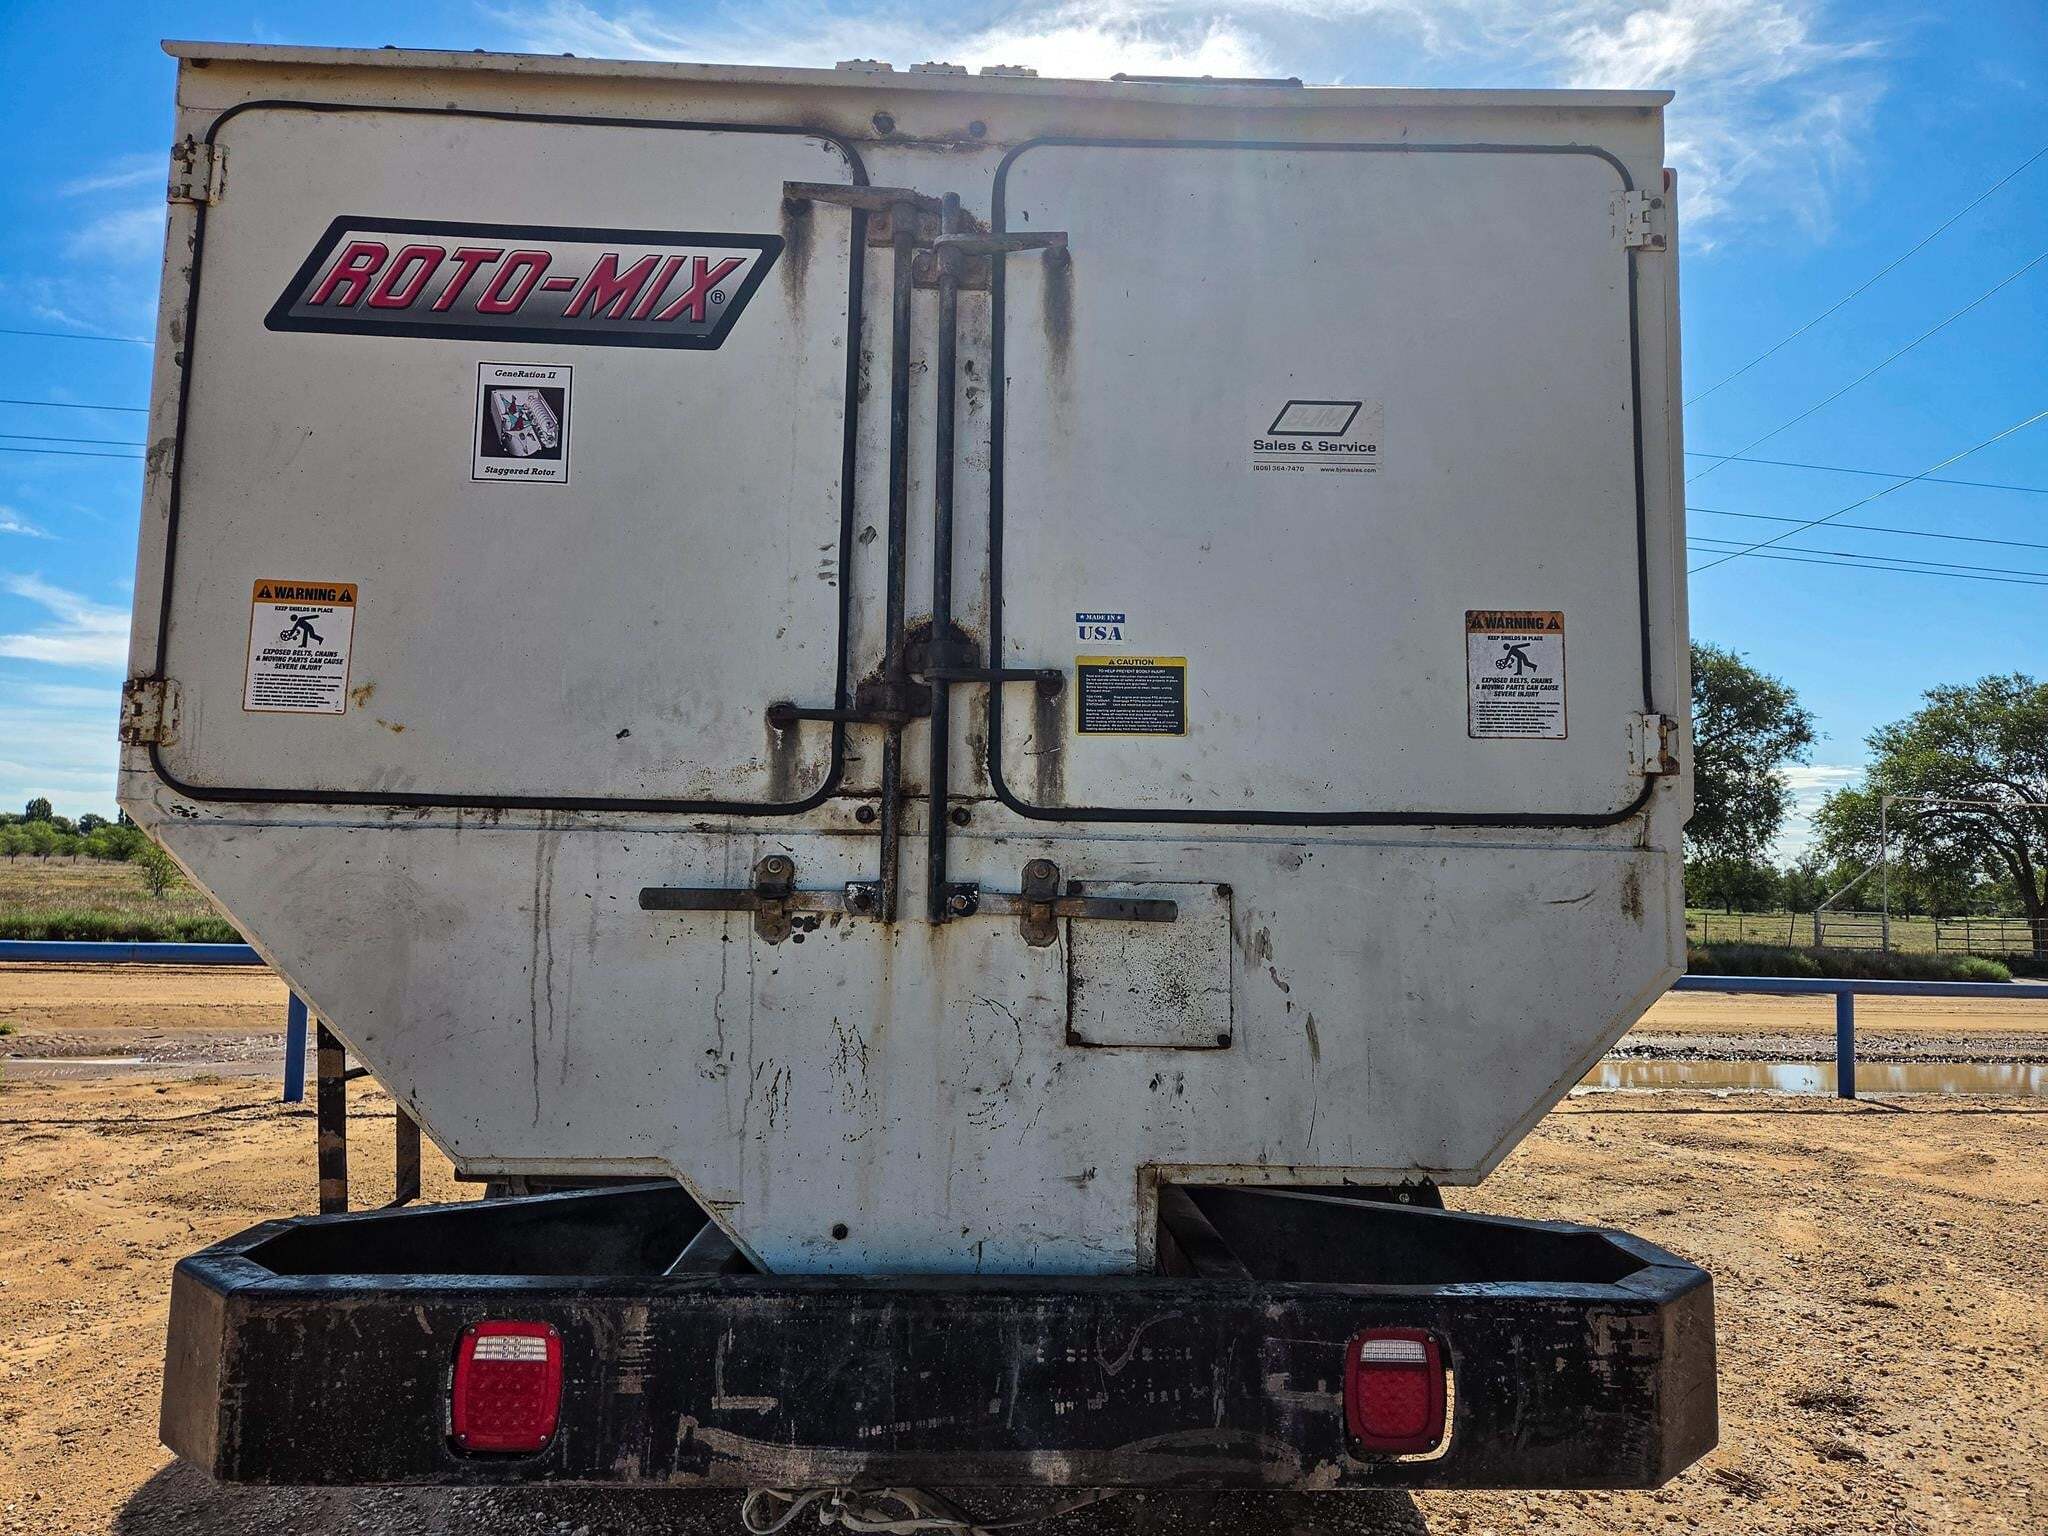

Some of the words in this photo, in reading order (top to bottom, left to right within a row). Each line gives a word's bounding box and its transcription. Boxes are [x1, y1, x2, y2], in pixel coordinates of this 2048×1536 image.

[306, 241, 747, 322] ROTO-MIX
[495, 369, 546, 379] GeneRation
[547, 371, 557, 379] II
[1253, 439, 1296, 451] Sales
[1301, 441, 1313, 451] &
[1318, 441, 1376, 452] Service
[484, 465, 530, 475] Staggered
[531, 467, 556, 476] Rotor
[274, 586, 337, 601] WARNING
[1486, 617, 1544, 630] WARNING
[1078, 625, 1123, 641] USA
[263, 648, 291, 656] EXPOSED
[292, 649, 313, 657] BELTS,
[314, 650, 338, 658] CHAINS
[261, 655, 287, 663] MOVING
[287, 656, 309, 664] PARTS
[309, 657, 323, 665] CAN
[1116, 658, 1154, 666] CAUTION
[274, 663, 299, 671] SEVERE
[1509, 677, 1530, 685] BELTS,
